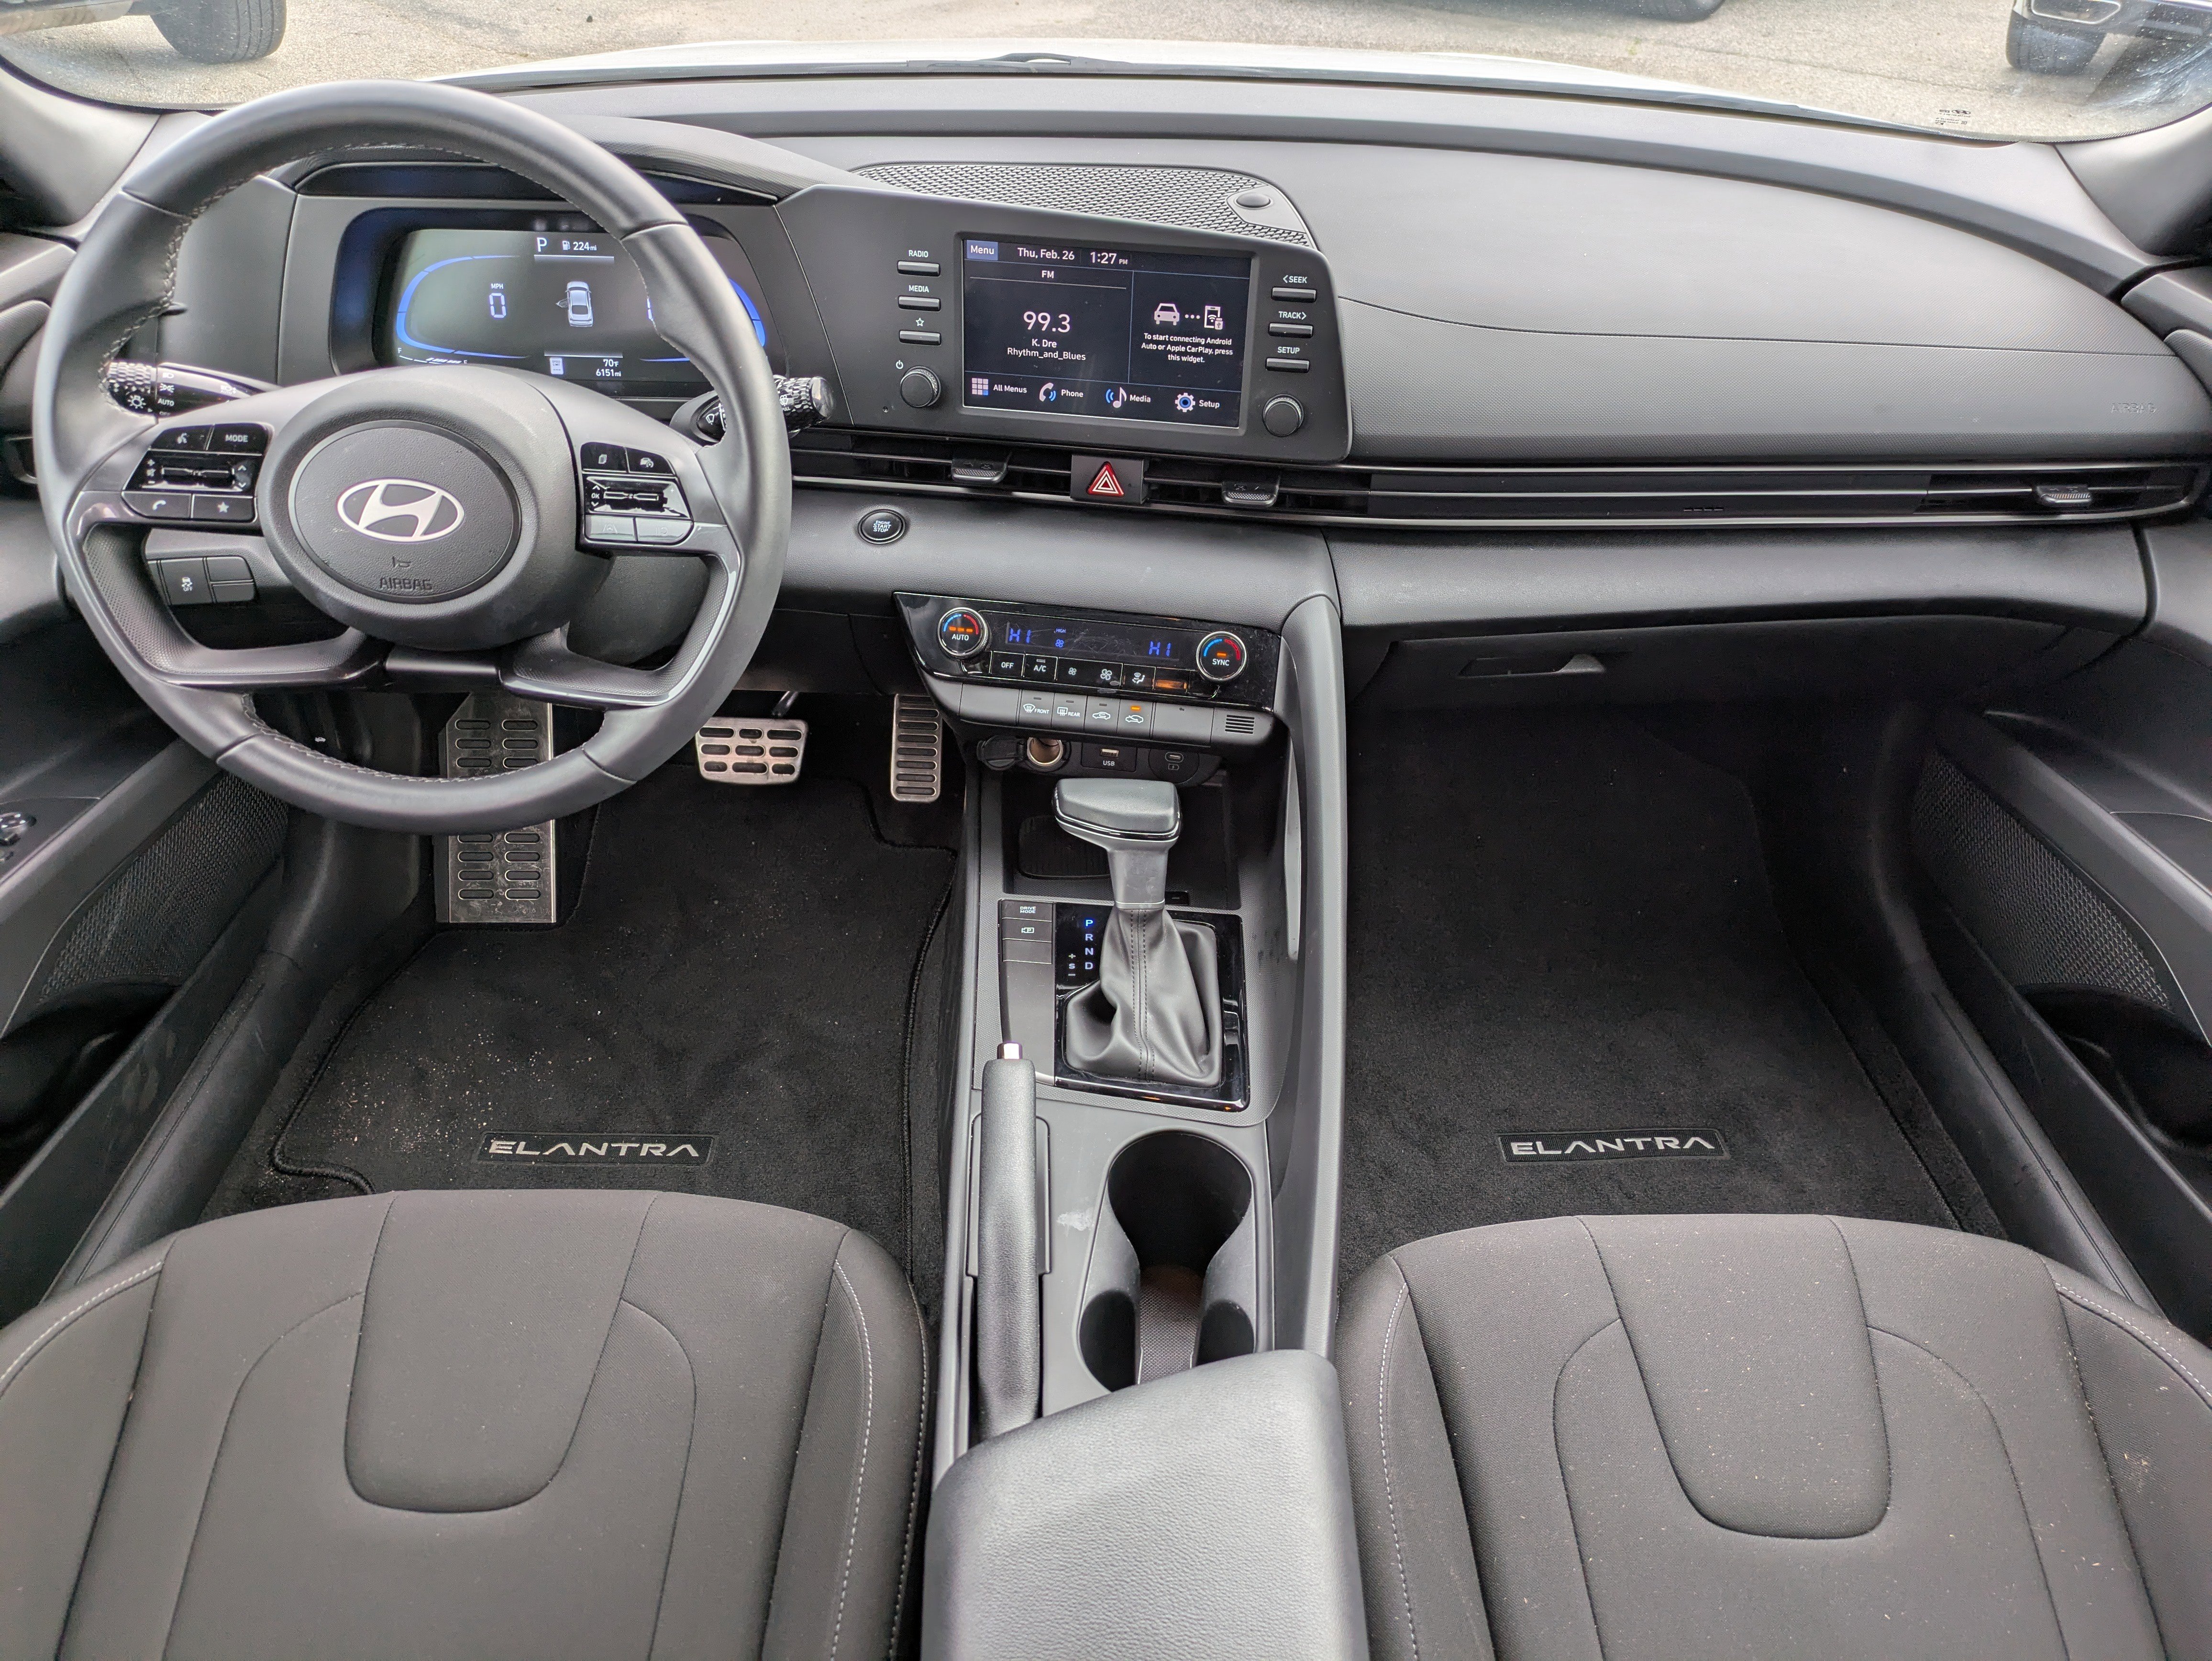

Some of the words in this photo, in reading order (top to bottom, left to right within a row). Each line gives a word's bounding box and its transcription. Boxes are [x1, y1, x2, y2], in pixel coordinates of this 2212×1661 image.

[537, 237, 547, 252] P
[971, 245, 995, 255] Menu
[1018, 248, 1038, 258] Thu,
[1040, 249, 1060, 259] Feb.
[1062, 251, 1075, 260] 26
[1090, 252, 1117, 264] 1:27
[1041, 270, 1054, 278] FM
[1023, 311, 1071, 332] 99.3
[1042, 340, 1057, 348] Dre
[1170, 335, 1205, 344] connecting
[1007, 348, 1086, 360] Rhythm_and_Blues
[1167, 344, 1185, 354] Apple
[1187, 346, 1213, 355] CarPlay,
[1062, 389, 1084, 398] Phone
[1129, 394, 1151, 403] Media
[158, 398, 175, 407] AUTO
[1199, 400, 1220, 409] Setup
[380, 577, 432, 590] AIRBAG
[488, 1140, 699, 1157] ELANTRA
[1511, 1137, 1715, 1155] ELANTRA
